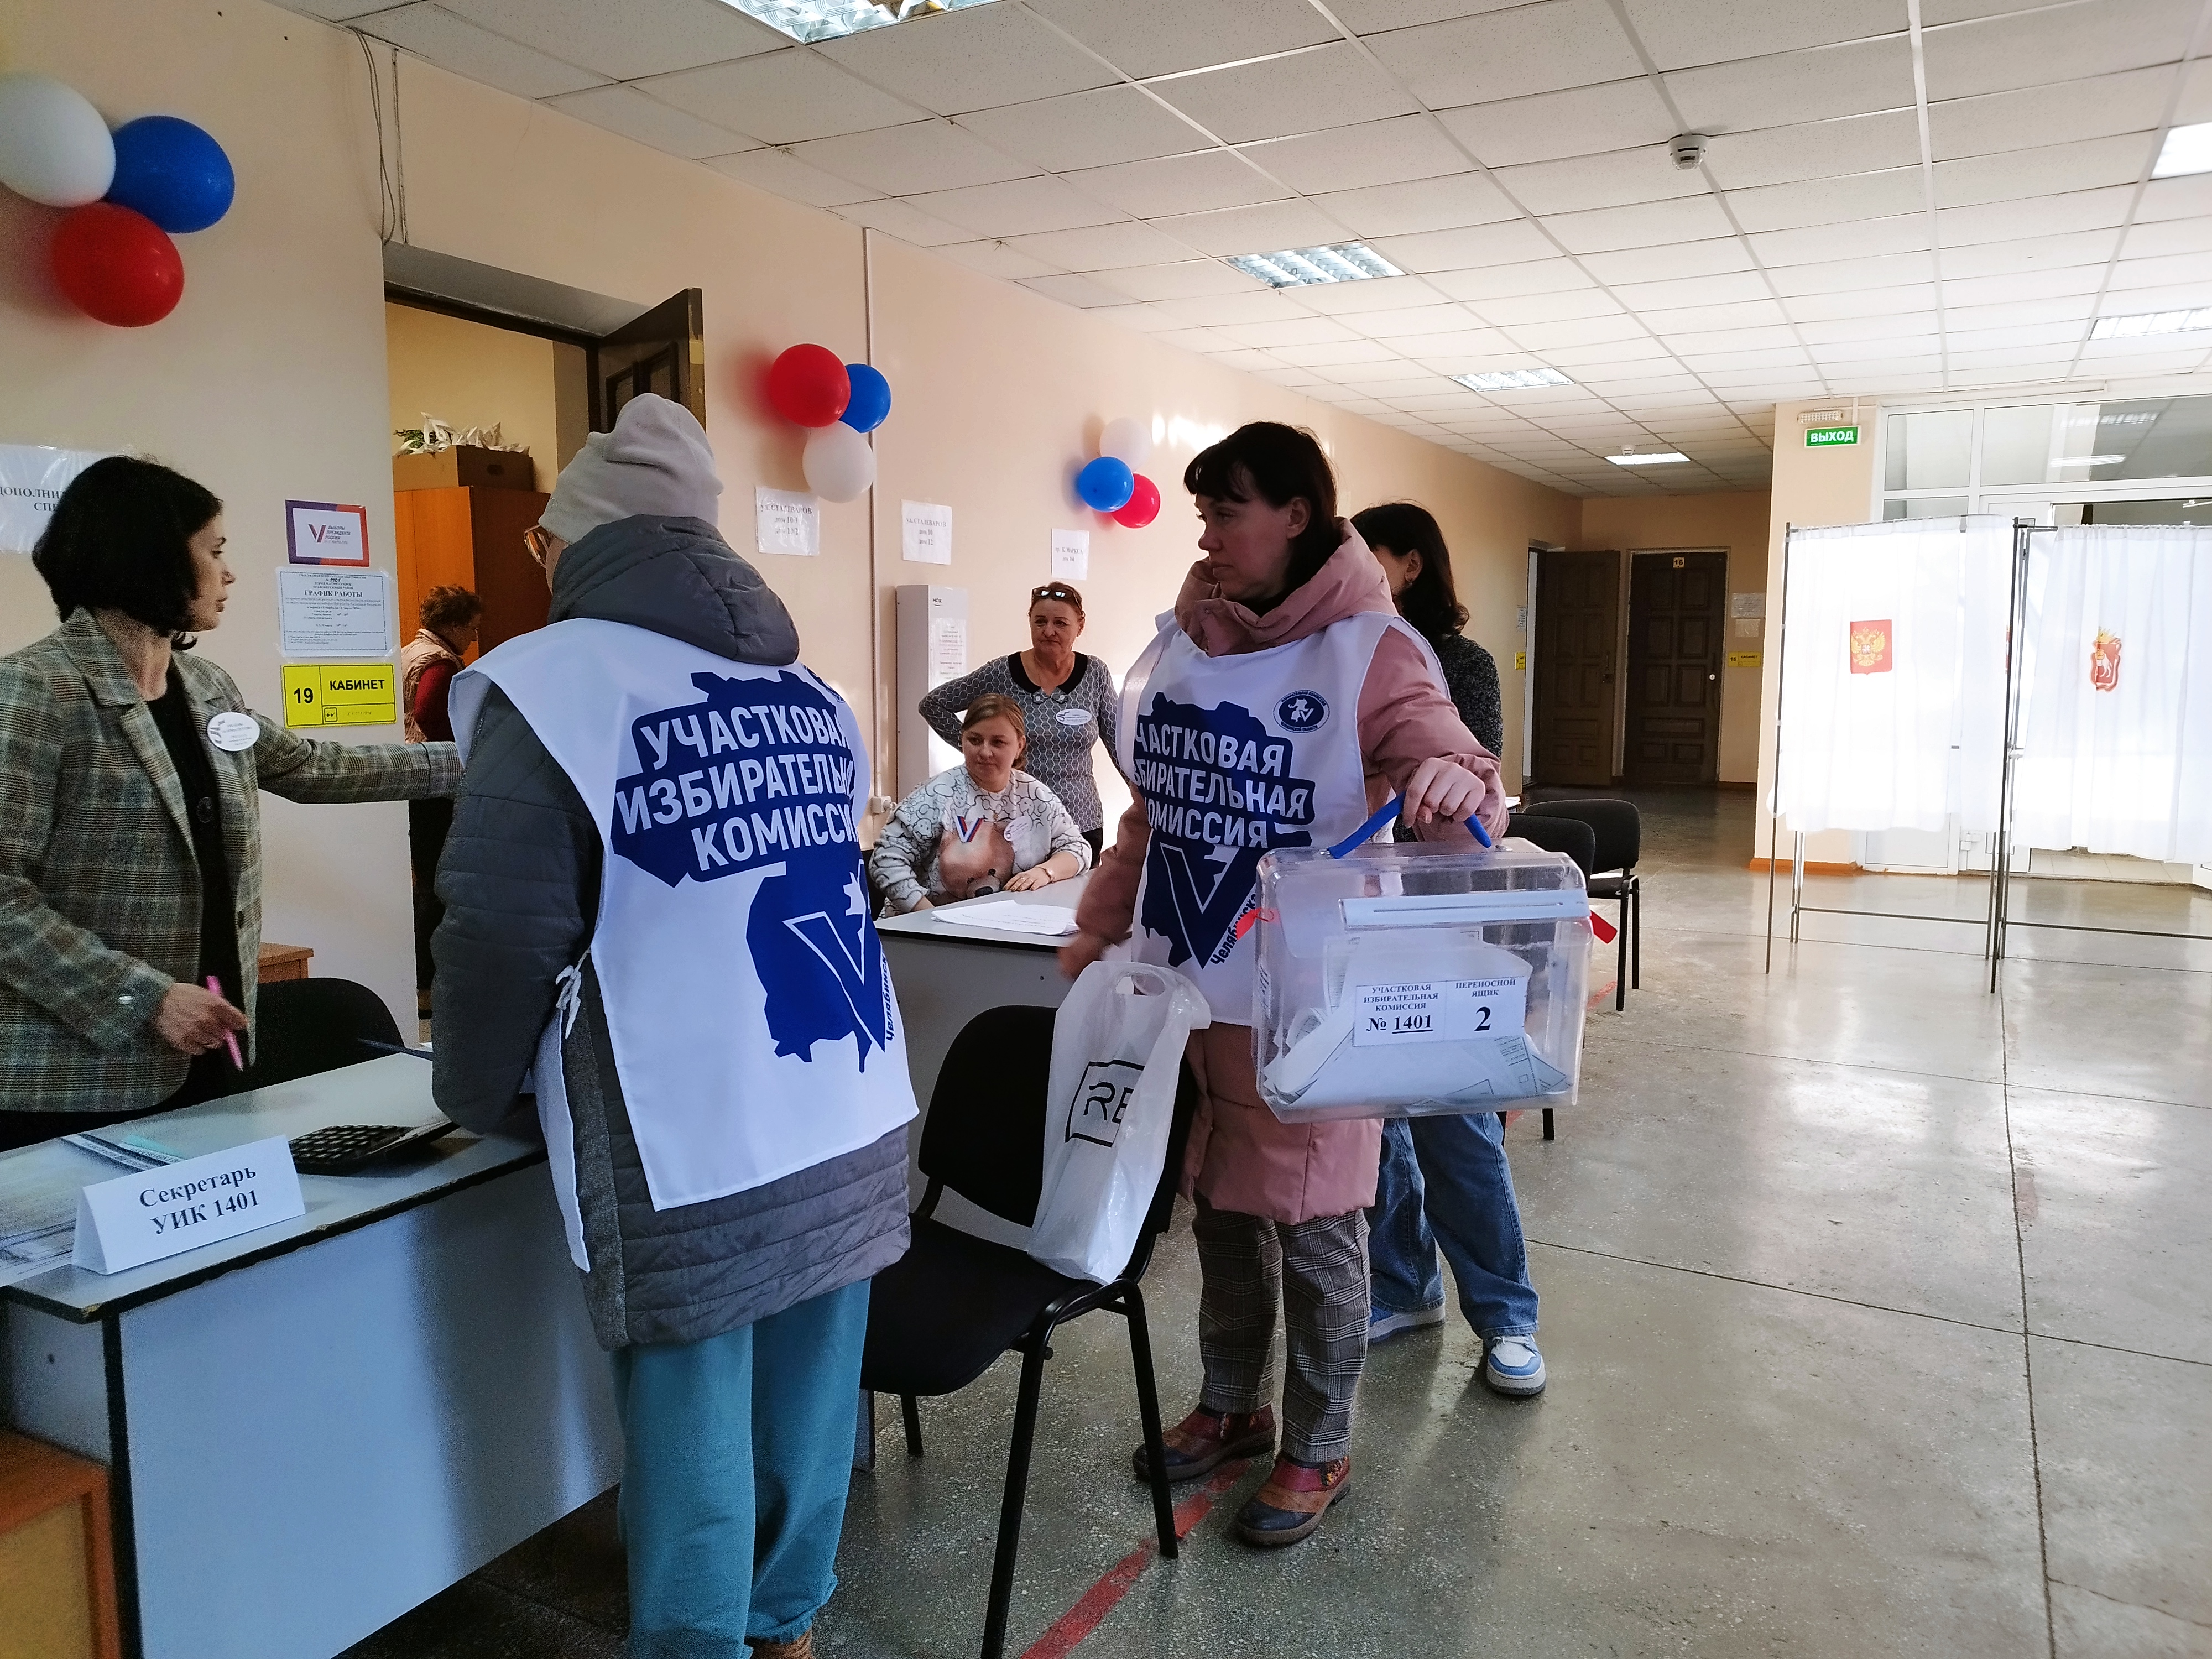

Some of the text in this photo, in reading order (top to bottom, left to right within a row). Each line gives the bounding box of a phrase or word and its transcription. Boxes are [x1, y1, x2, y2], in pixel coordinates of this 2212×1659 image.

[1811, 430, 1854, 442] ВЫХОД
[0, 486, 62, 499] ОПОЛНИ
[293, 679, 385, 704] 19 КАБИНЕТ
[1135, 722, 1285, 777] ЧАСТКОВАЯ
[1145, 796, 1269, 848] ОМИССИЯ
[690, 802, 859, 872] КОМИССИ
[1371, 984, 1431, 994] УЧАСТКОВАЯ
[1455, 978, 1516, 989] ПЕРЕНОСНОЙ
[1364, 993, 1439, 1003] ИЗБИРАТЕЛЬНАЯ
[1375, 1003, 1427, 1012] КОМИССИЯ
[1365, 1014, 1432, 1032] № 1401
[1473, 1006, 1491, 1032] 2
[139, 1167, 257, 1207] Секретарь
[150, 1190, 259, 1234] УИК 1401
